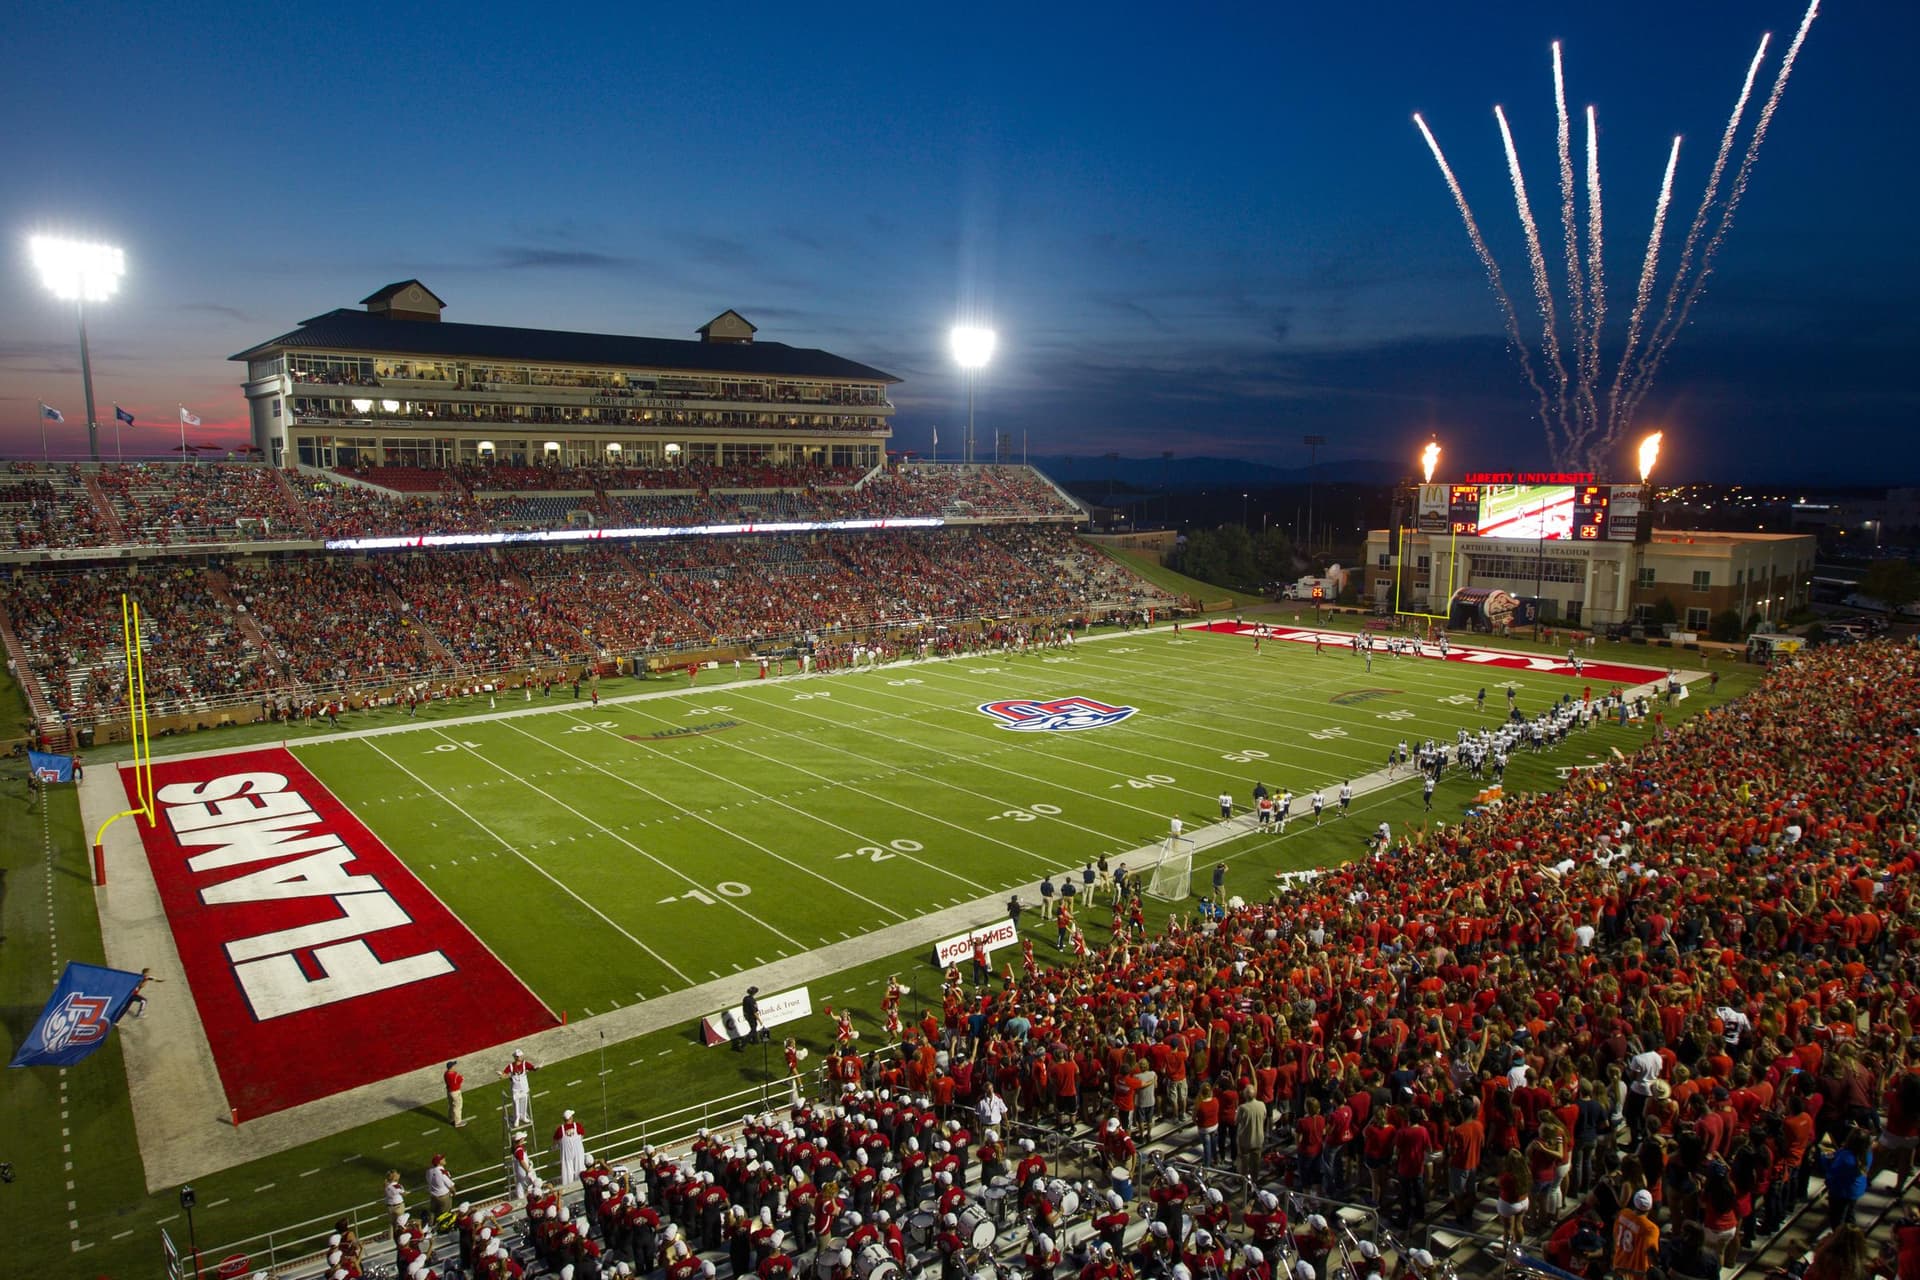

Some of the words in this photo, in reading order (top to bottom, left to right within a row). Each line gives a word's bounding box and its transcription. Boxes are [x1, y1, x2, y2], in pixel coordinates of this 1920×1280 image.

[1465, 472, 1514, 483] LIBERTY
[1518, 472, 1594, 483] UNIVERSITY
[1583, 494, 1591, 504] 6
[1582, 527, 1596, 537] 25
[1461, 543, 1491, 551] ARTHUR
[1504, 545, 1549, 554] WILLIAMS
[1551, 548, 1590, 556] STADIUM
[1312, 588, 1323, 597] 25
[689, 705, 734, 715] 30
[571, 721, 619, 732] 20
[1308, 727, 1348, 740] 40
[434, 741, 483, 752] 10
[1221, 749, 1270, 763] 50
[1127, 774, 1176, 789] 40
[1002, 803, 1062, 822] 30
[856, 838, 924, 863] 20
[155, 771, 460, 1023] FLAMES
[681, 881, 752, 905] 10
